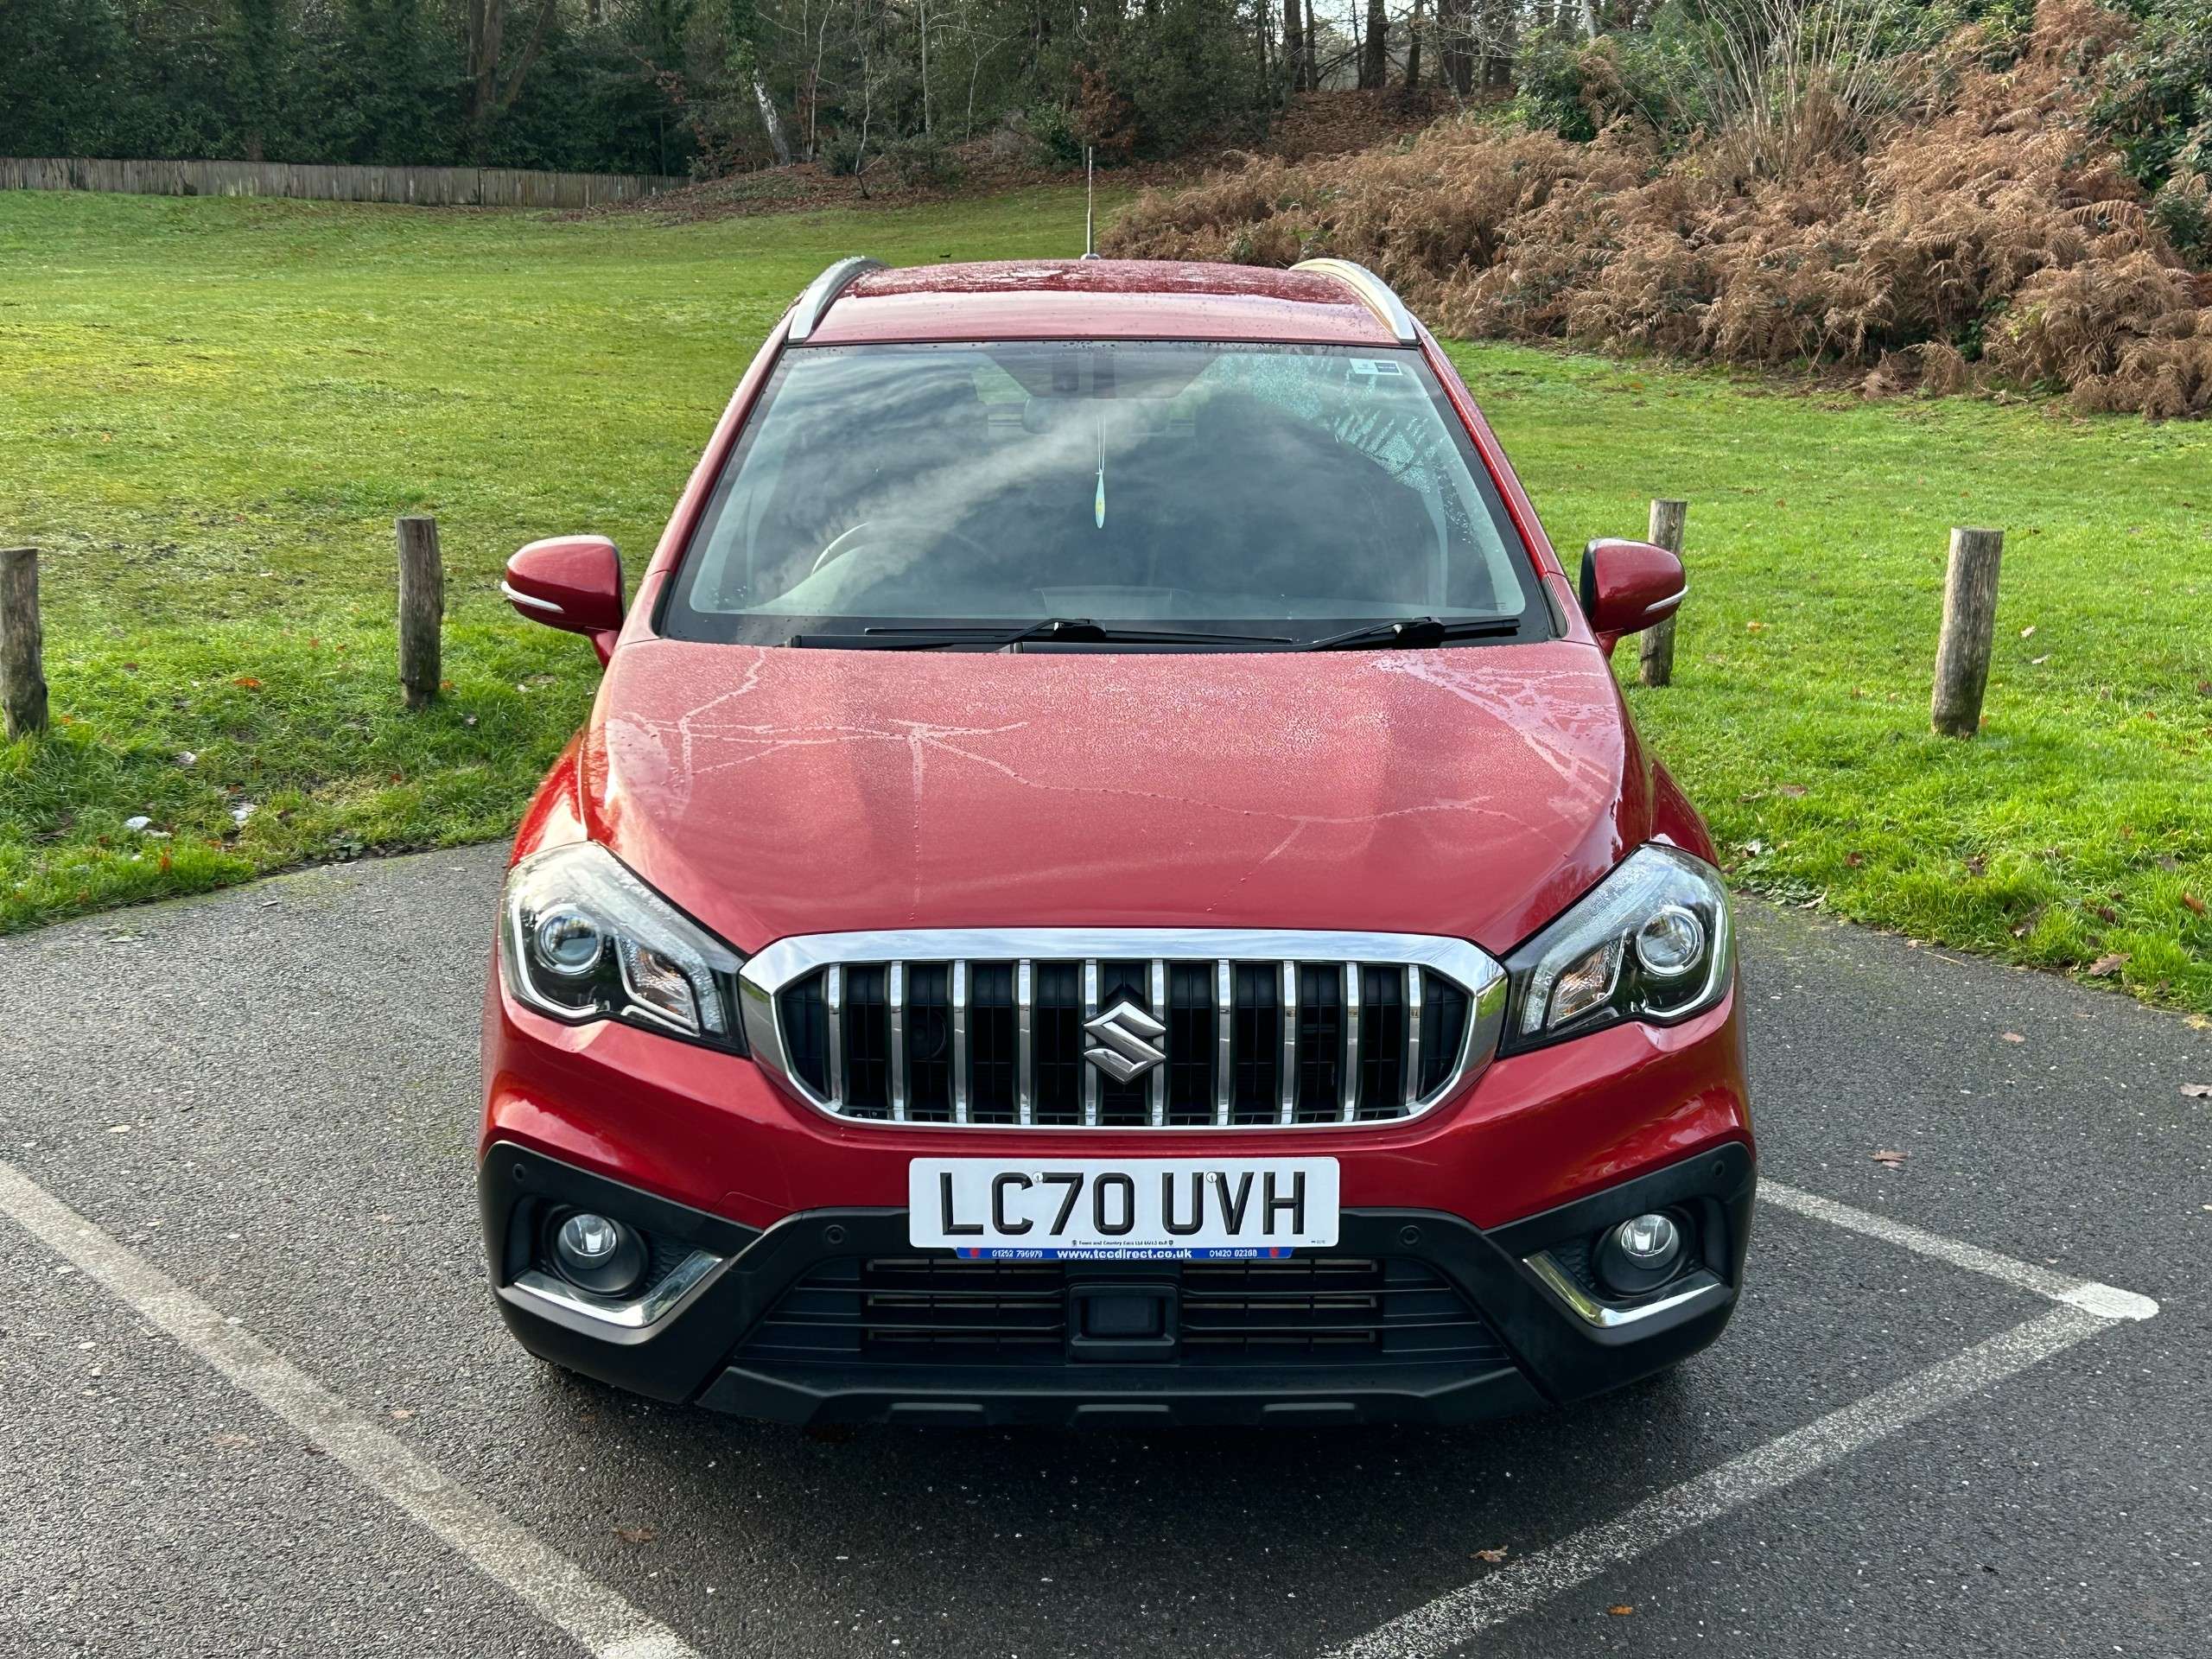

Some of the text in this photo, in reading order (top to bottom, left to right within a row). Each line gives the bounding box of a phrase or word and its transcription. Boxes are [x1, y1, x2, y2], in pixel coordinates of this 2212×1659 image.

[939, 1172, 1306, 1236] LC70 UVH
[1057, 1248, 1192, 1259] www.tccdirect.co.uk
